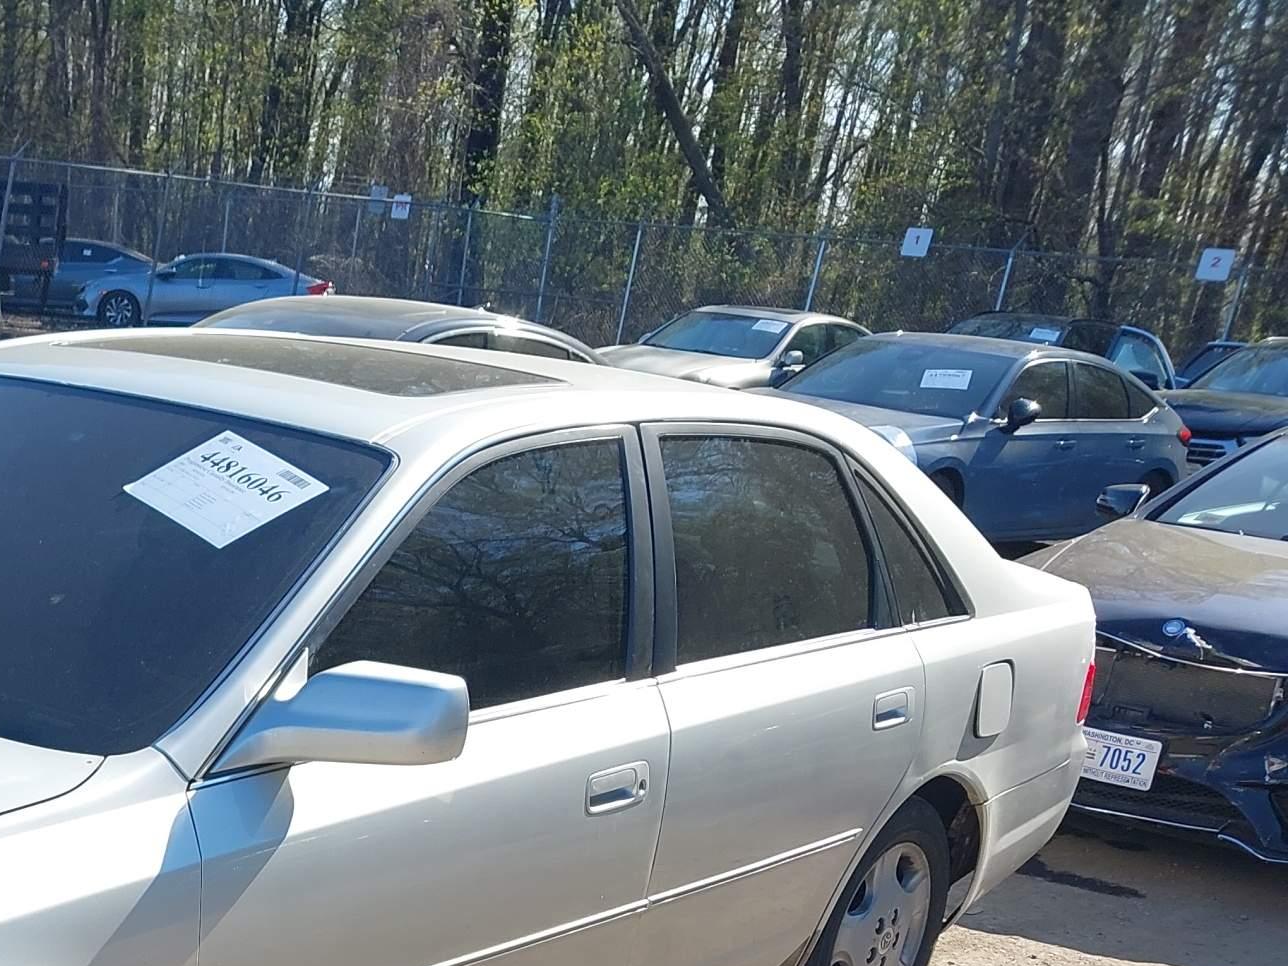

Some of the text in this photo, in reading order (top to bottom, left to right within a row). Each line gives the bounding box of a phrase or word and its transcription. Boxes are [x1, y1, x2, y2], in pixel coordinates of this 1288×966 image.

[1210, 255, 1223, 268] 2
[200, 451, 291, 502] 44816046
[1099, 744, 1146, 775] 7052
